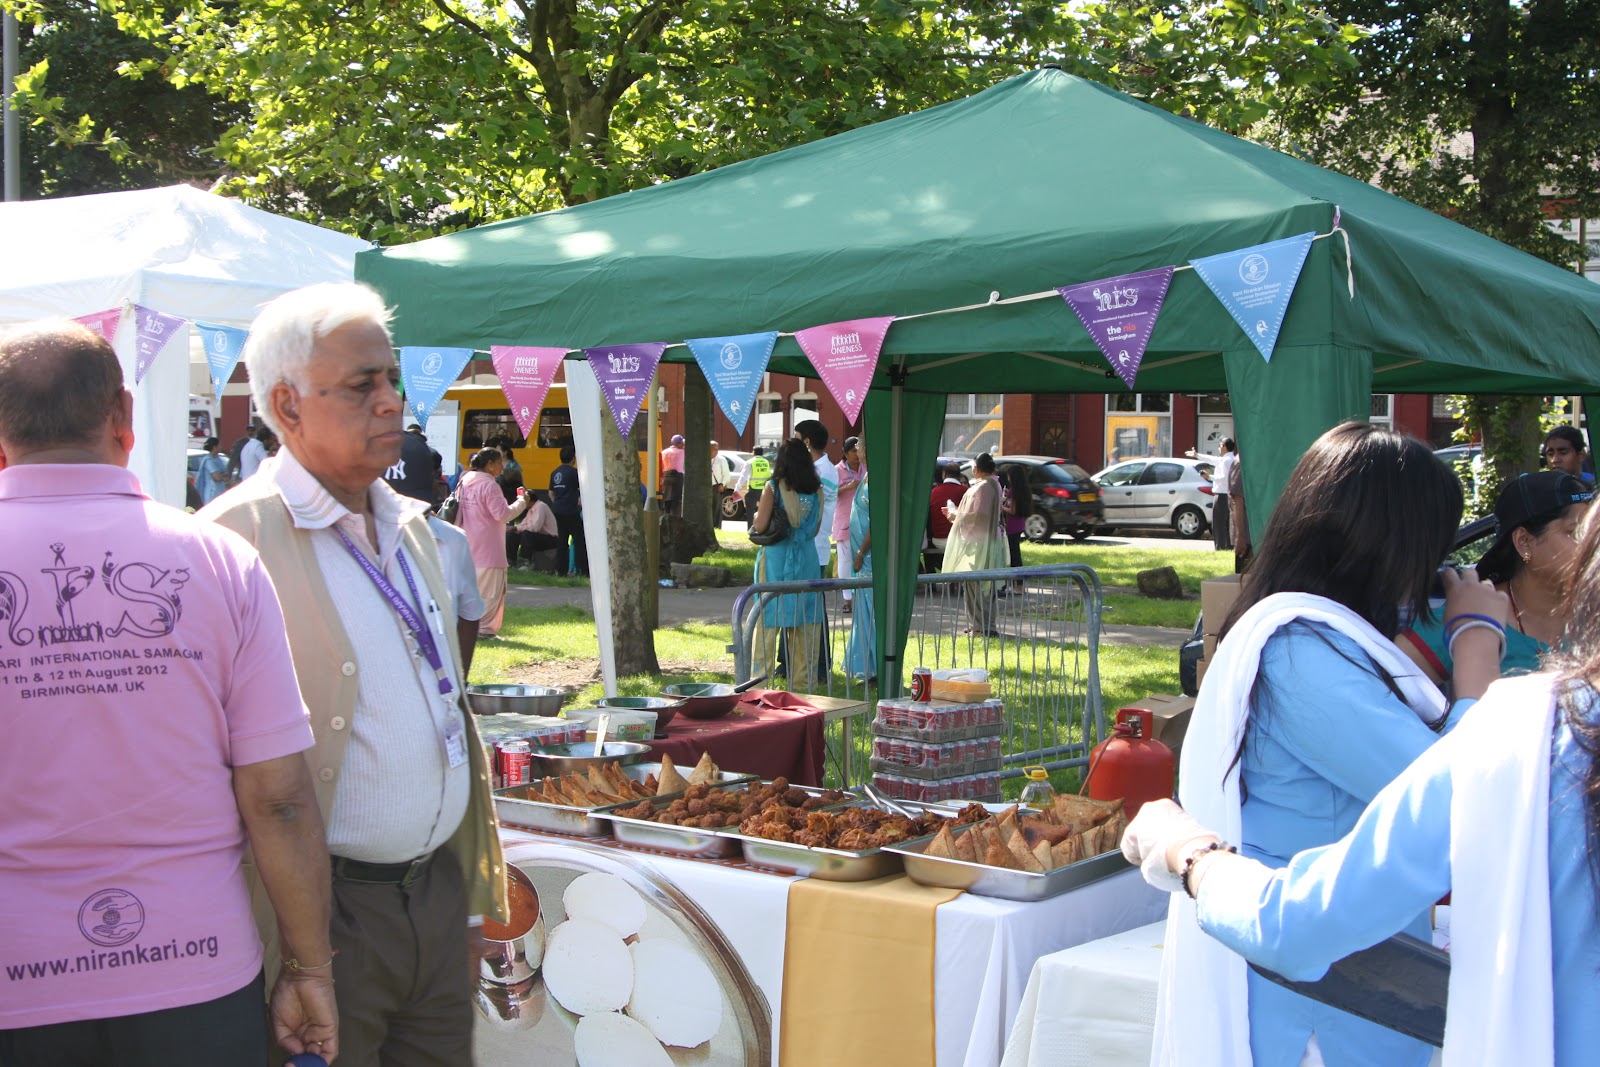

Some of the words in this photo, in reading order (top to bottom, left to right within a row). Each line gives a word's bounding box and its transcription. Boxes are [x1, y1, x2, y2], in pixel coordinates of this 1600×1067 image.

[1107, 326, 1122, 335] the
[1108, 333, 1136, 342] birmingham
[831, 343, 863, 354] ONENESS
[513, 366, 538, 374] ONENESS
[614, 386, 625, 394] the
[351, 547, 395, 598] INTERNATIONAL
[392, 596, 421, 632] NIRANKARI
[31, 649, 139, 666] INTERNATIONAL
[33, 672, 43, 683] &
[49, 670, 65, 680] 12
[86, 666, 132, 679] August
[136, 664, 168, 675] 2012
[126, 681, 145, 692] UK
[6, 936, 219, 981] www.nirankari.org
